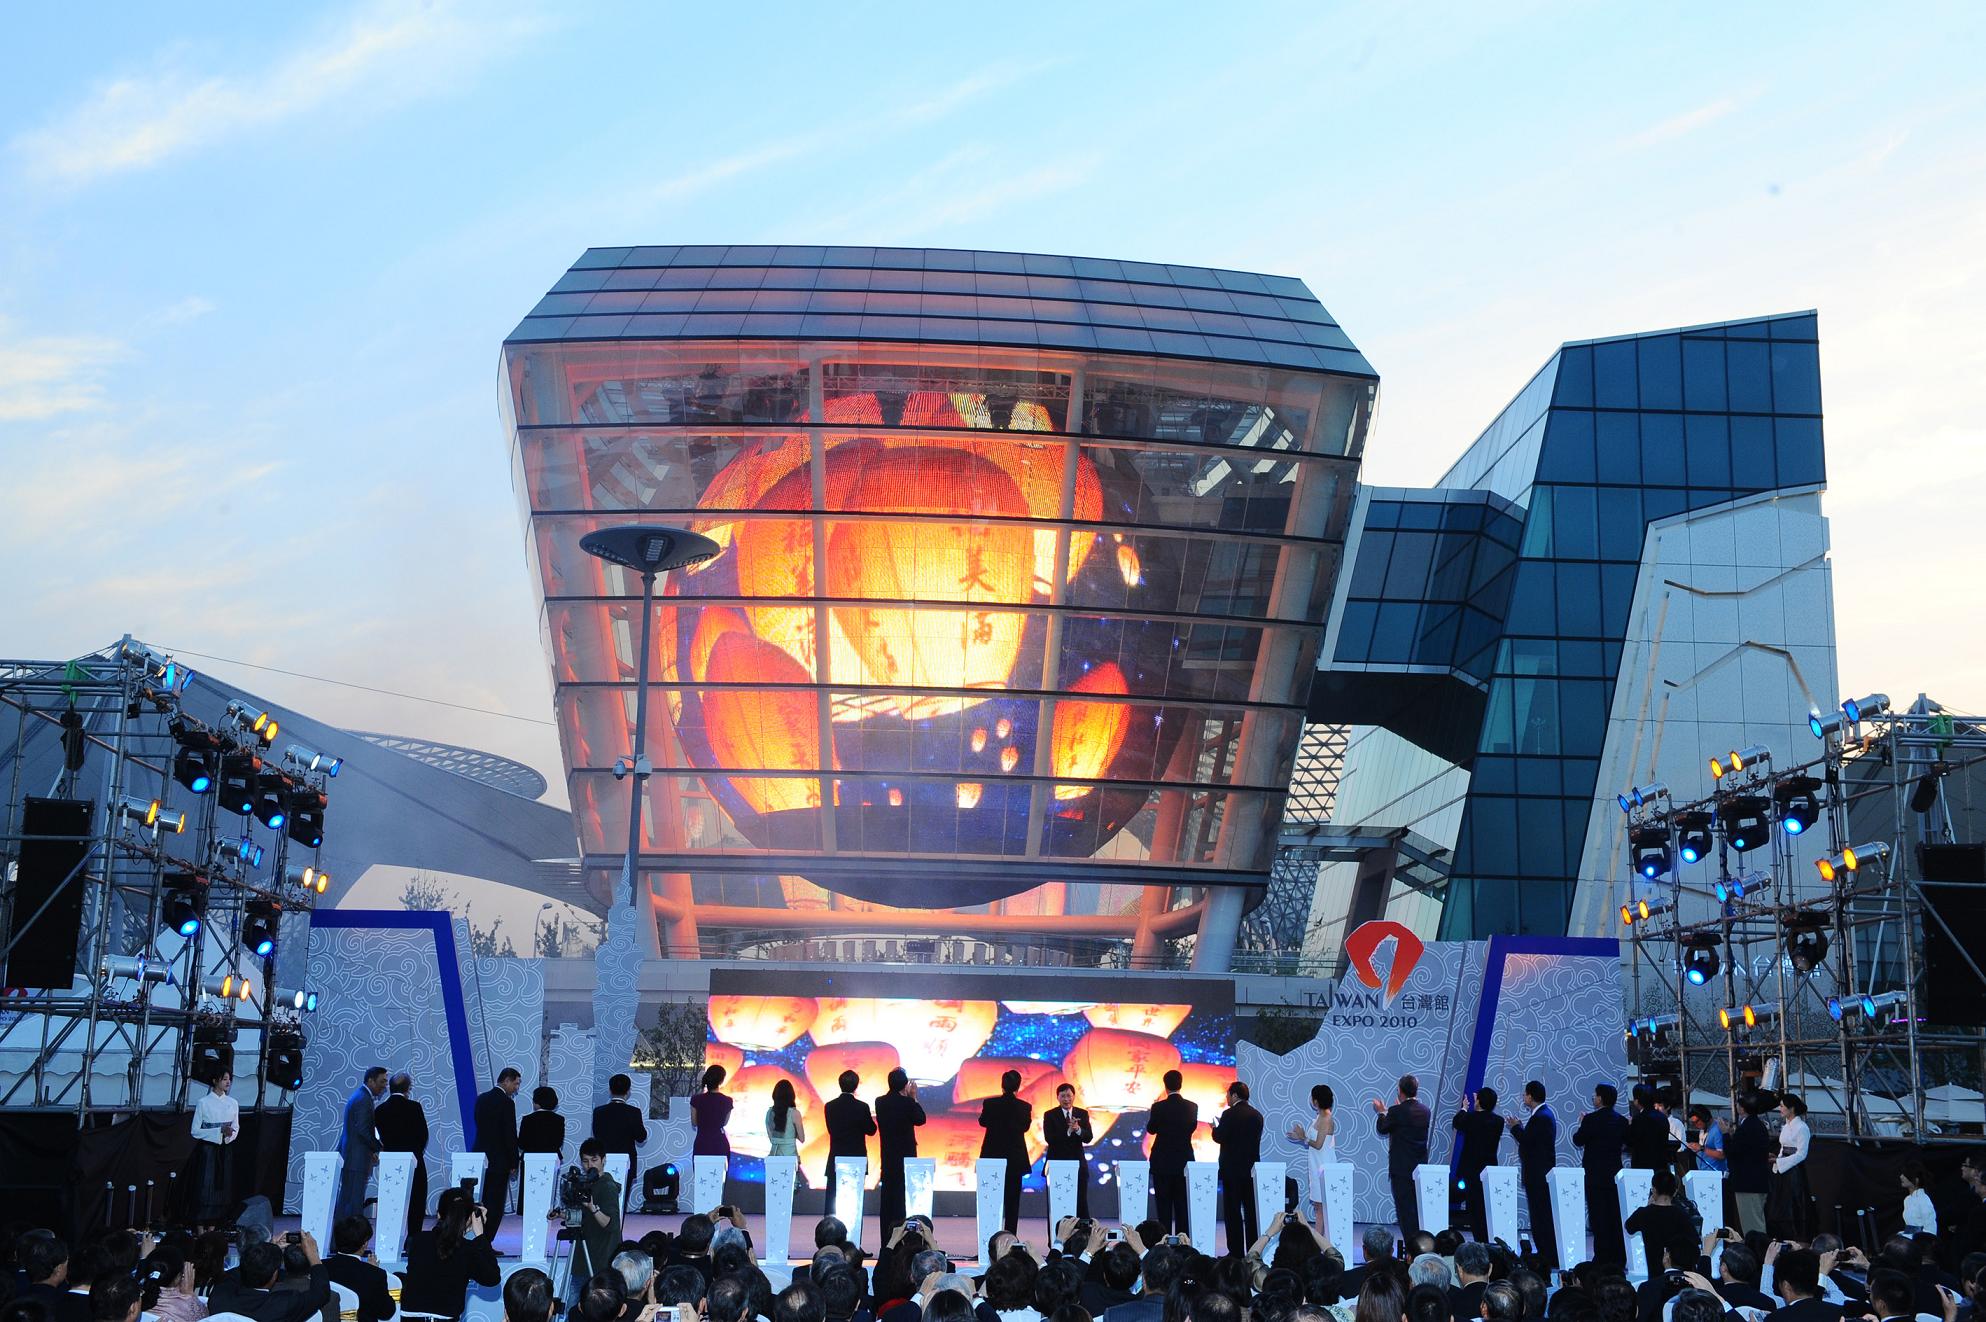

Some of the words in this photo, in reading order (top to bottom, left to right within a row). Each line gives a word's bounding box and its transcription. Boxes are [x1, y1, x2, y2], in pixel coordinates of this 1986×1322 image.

[1303, 980, 1379, 1009] TAIWAN
[1401, 994, 1449, 1011] 台灣館
[1332, 1015, 1375, 1028] EXPO
[1379, 1015, 1418, 1028] 2010
